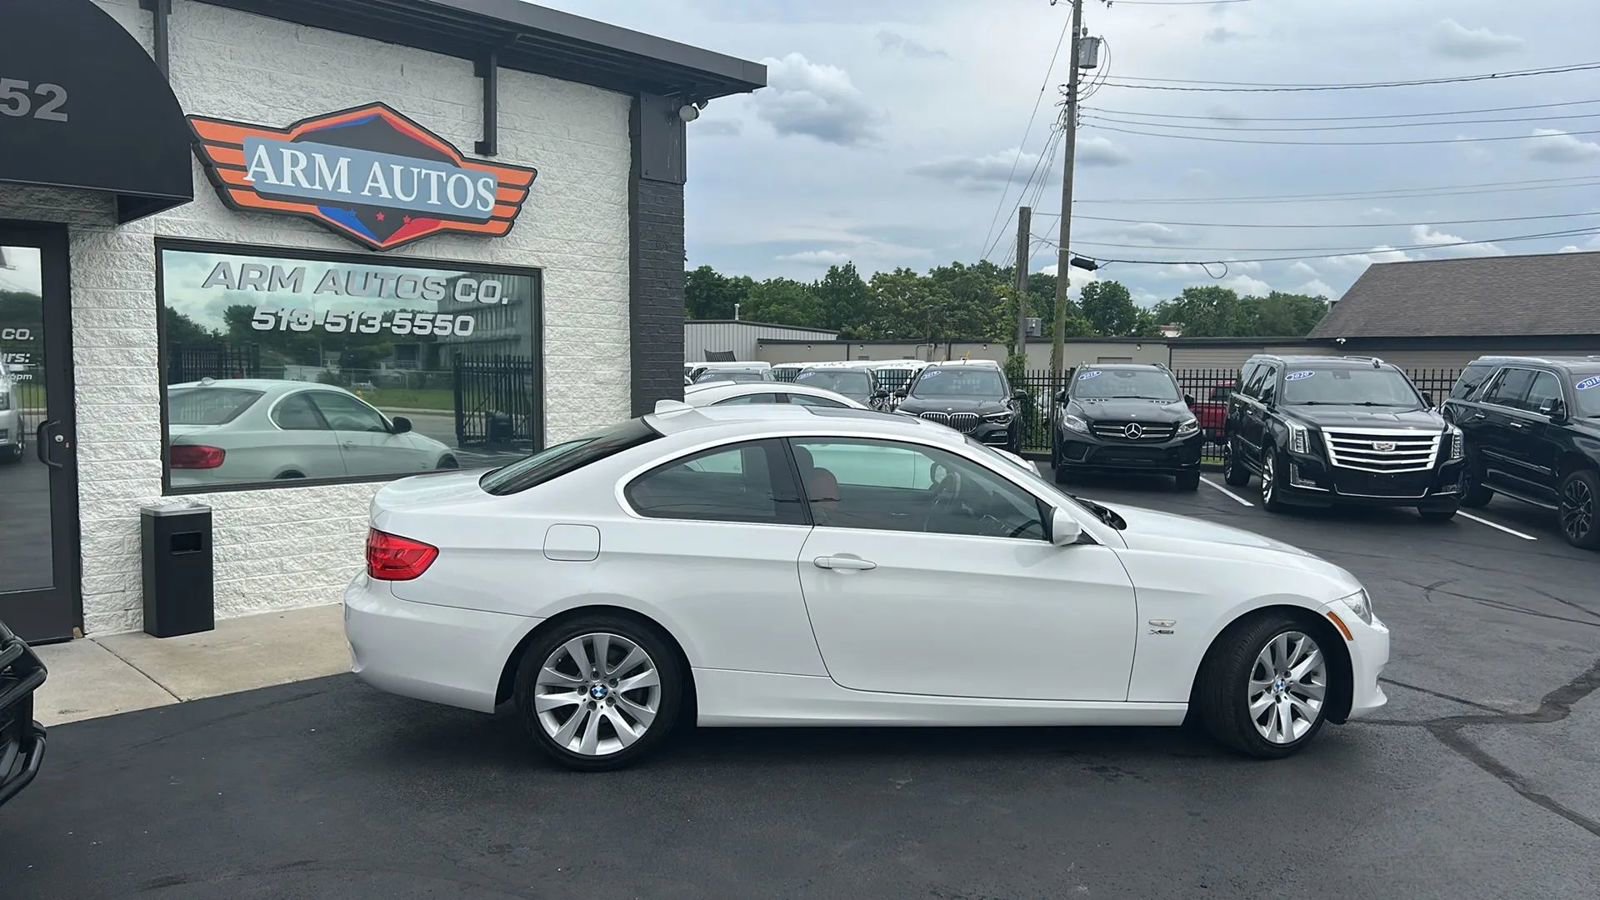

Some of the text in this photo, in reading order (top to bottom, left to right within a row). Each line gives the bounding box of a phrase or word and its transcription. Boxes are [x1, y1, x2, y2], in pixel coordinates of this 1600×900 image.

[0, 78, 68, 122] 52
[243, 144, 496, 212] ARM AUTOS
[201, 261, 509, 305] ARM AUTOS CO.
